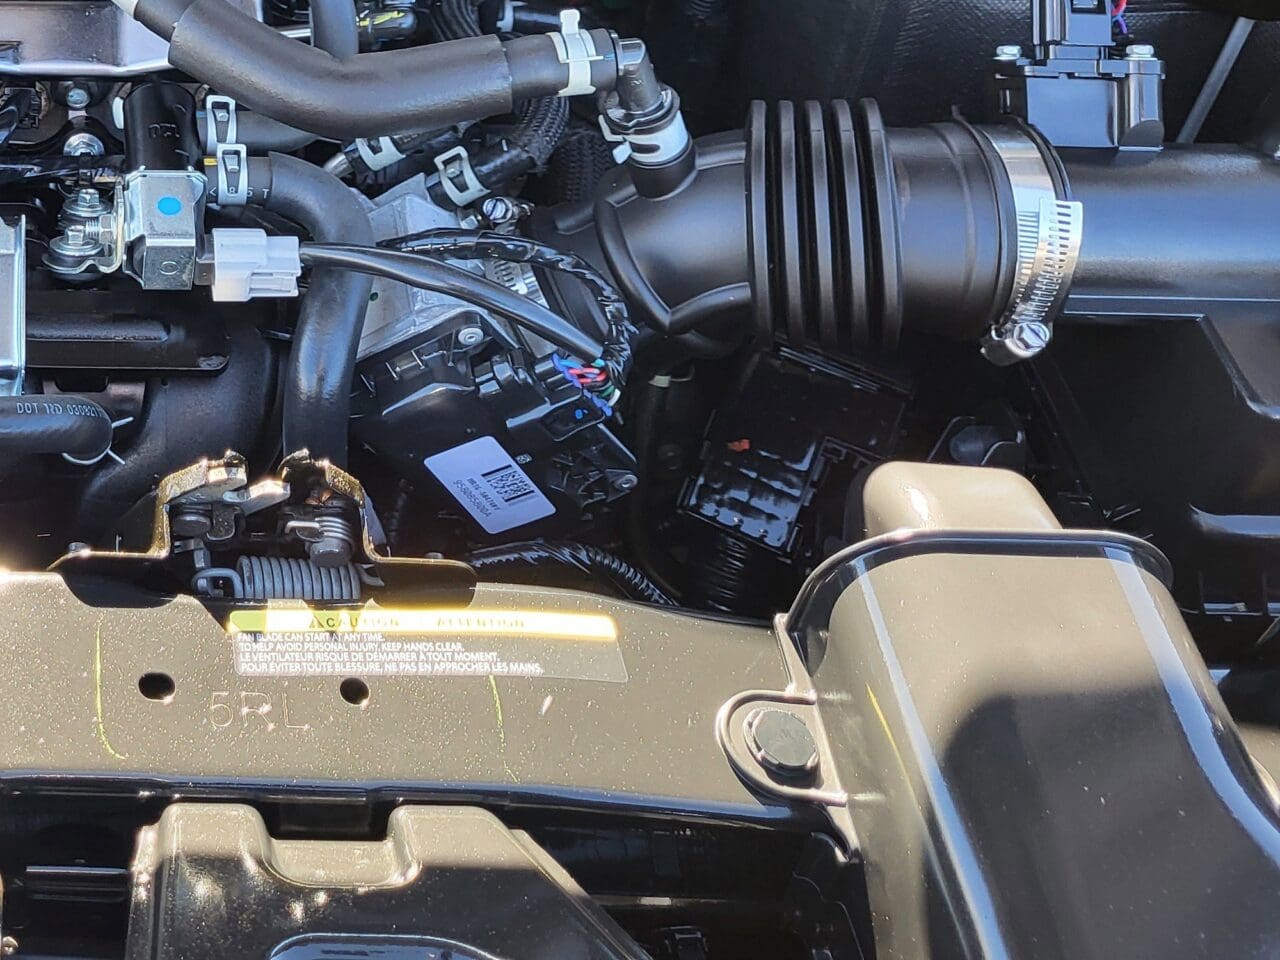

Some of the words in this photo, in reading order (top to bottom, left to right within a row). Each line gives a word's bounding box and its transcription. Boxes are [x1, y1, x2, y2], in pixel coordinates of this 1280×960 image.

[17, 403, 39, 414] DOT
[237, 632, 253, 641] FAN
[284, 632, 303, 641] CAN
[304, 632, 330, 641] START
[344, 633, 361, 641] ANY
[254, 642, 274, 651] HELP
[276, 642, 302, 651] AVOID
[304, 642, 348, 651] PERSONAL
[382, 642, 403, 651] KEEP
[404, 642, 434, 651] HANDS
[253, 652, 313, 661] VENTILATEUR
[315, 652, 350, 662] RISQUE
[428, 652, 453, 661] TOUT
[241, 662, 268, 671] POUR
[303, 662, 333, 671] TOUTE
[399, 663, 417, 672] PAS
[433, 663, 490, 672] APPROCHER
[492, 663, 509, 672] LES
[210, 691, 310, 731] 5RL
